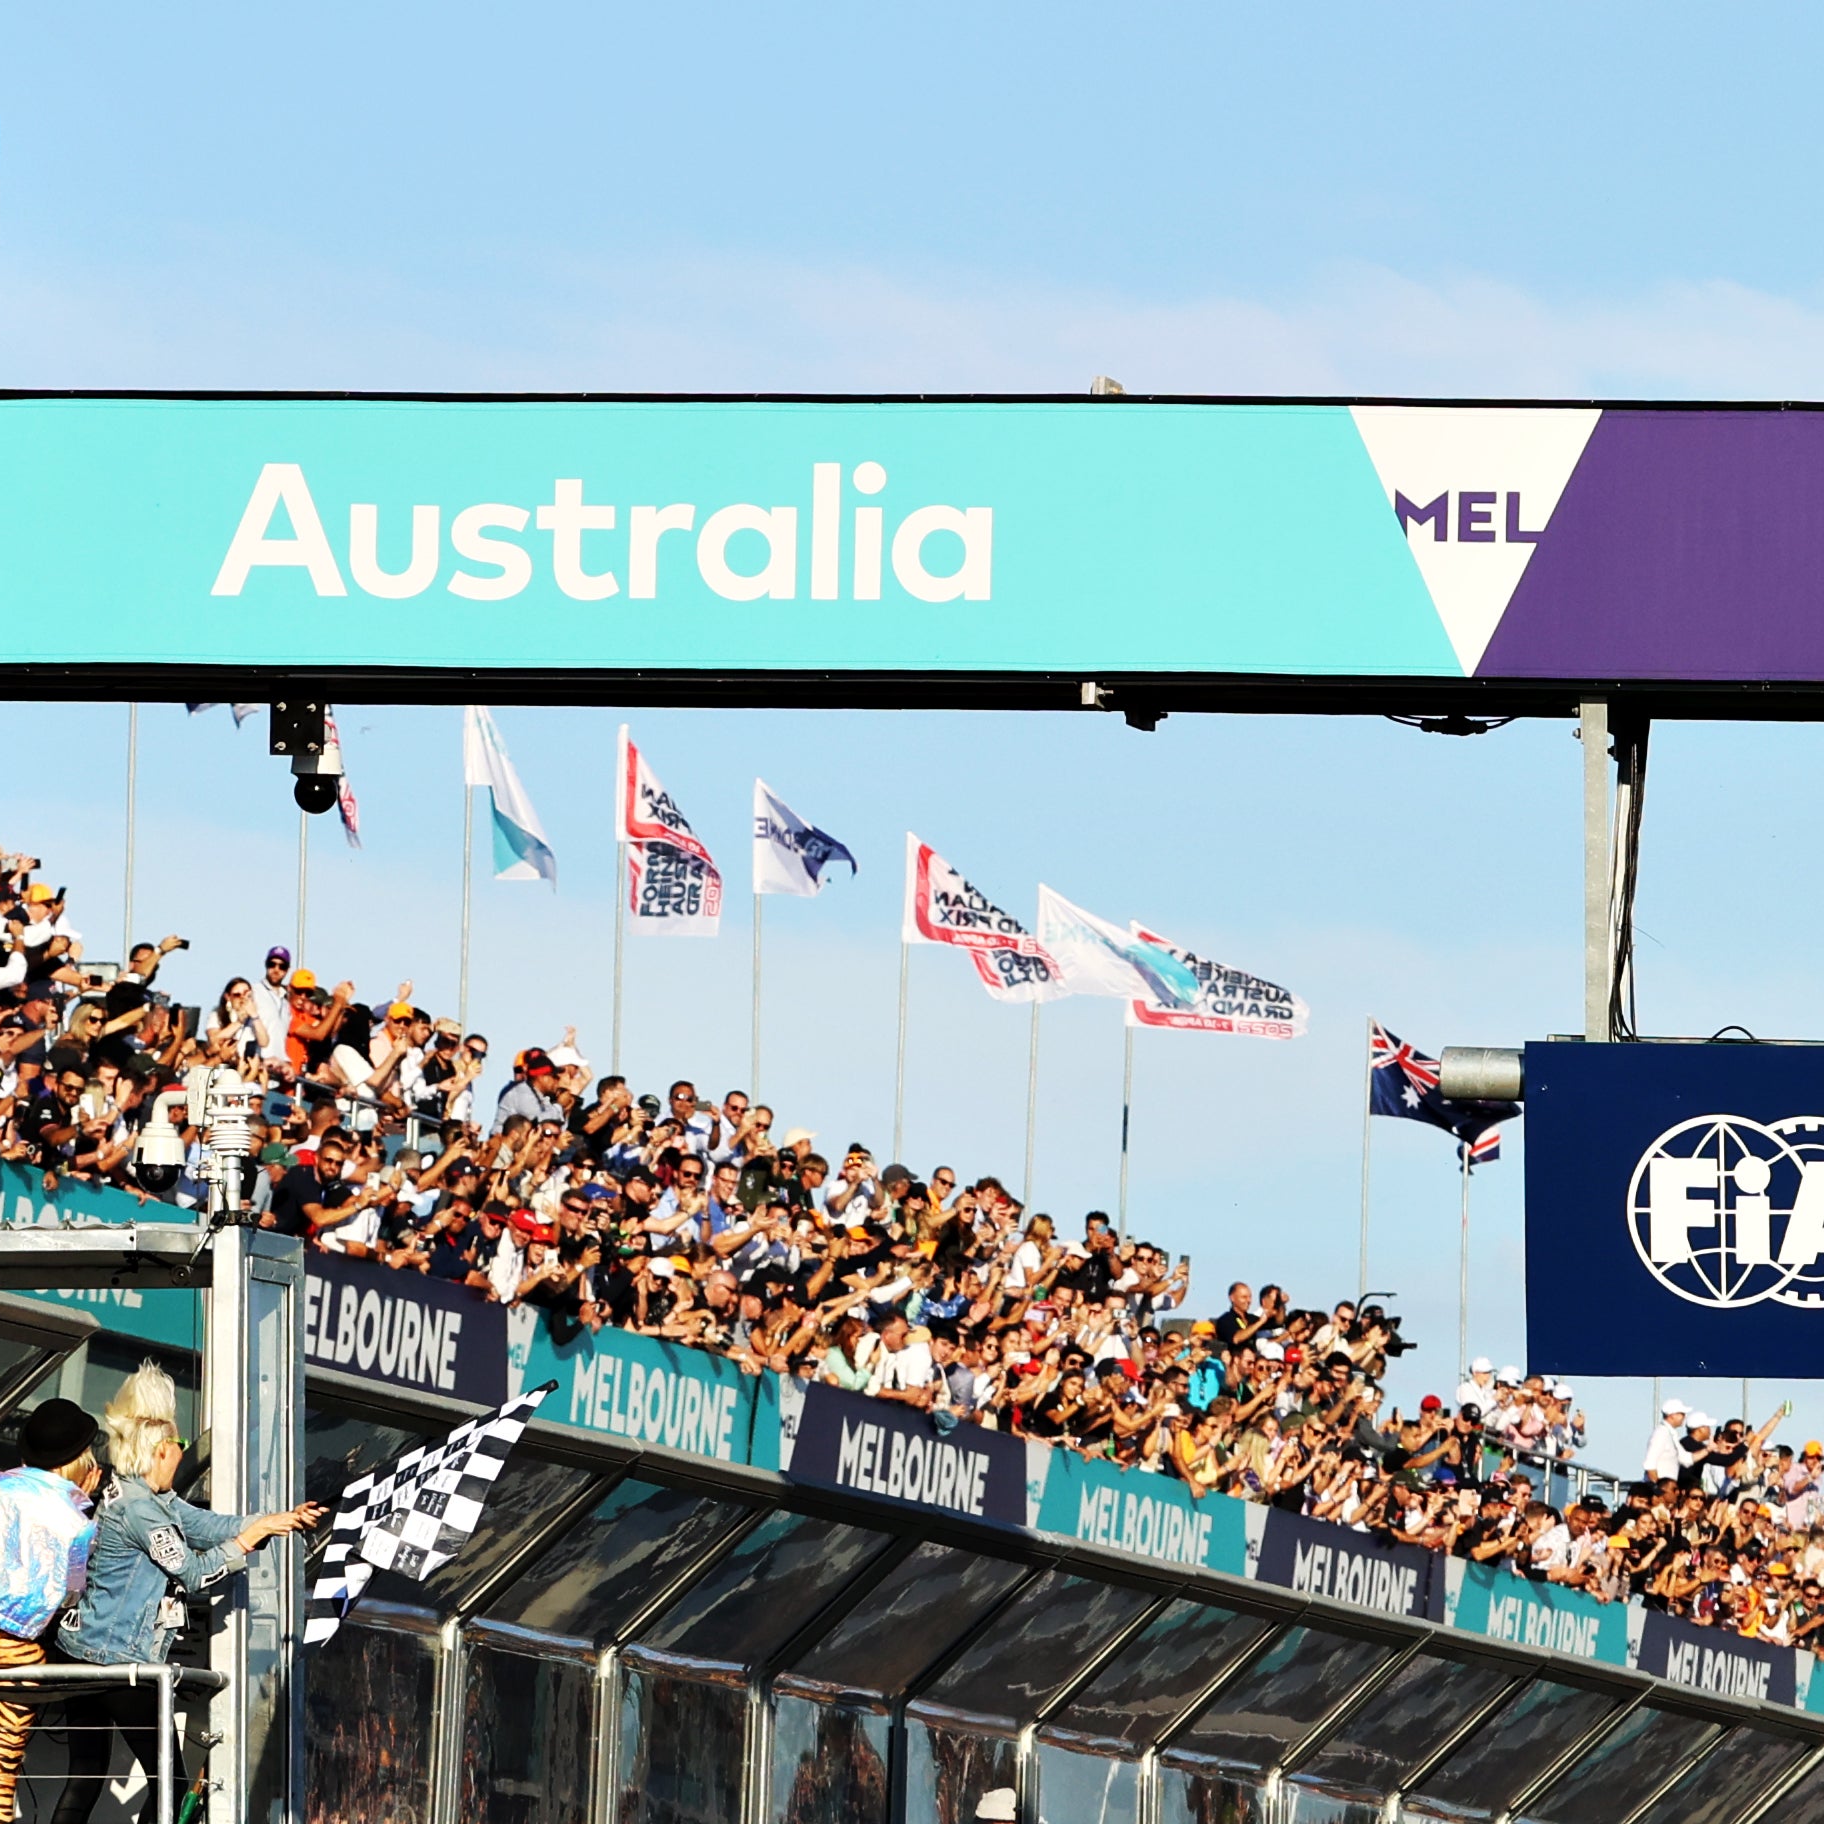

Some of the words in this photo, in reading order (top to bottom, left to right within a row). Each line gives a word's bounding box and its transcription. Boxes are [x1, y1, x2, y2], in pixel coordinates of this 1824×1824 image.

[210, 461, 993, 600] Australia
[1393, 487, 1547, 546] MEL
[303, 1273, 463, 1392] ELBOURNE
[569, 1350, 738, 1462] MELBOURNE
[836, 1415, 990, 1517] MELBOURNE
[1076, 1482, 1213, 1570] MELBOURNE
[1292, 1538, 1418, 1616] MELBOURNE
[1486, 1589, 1600, 1658] MELBOURNE
